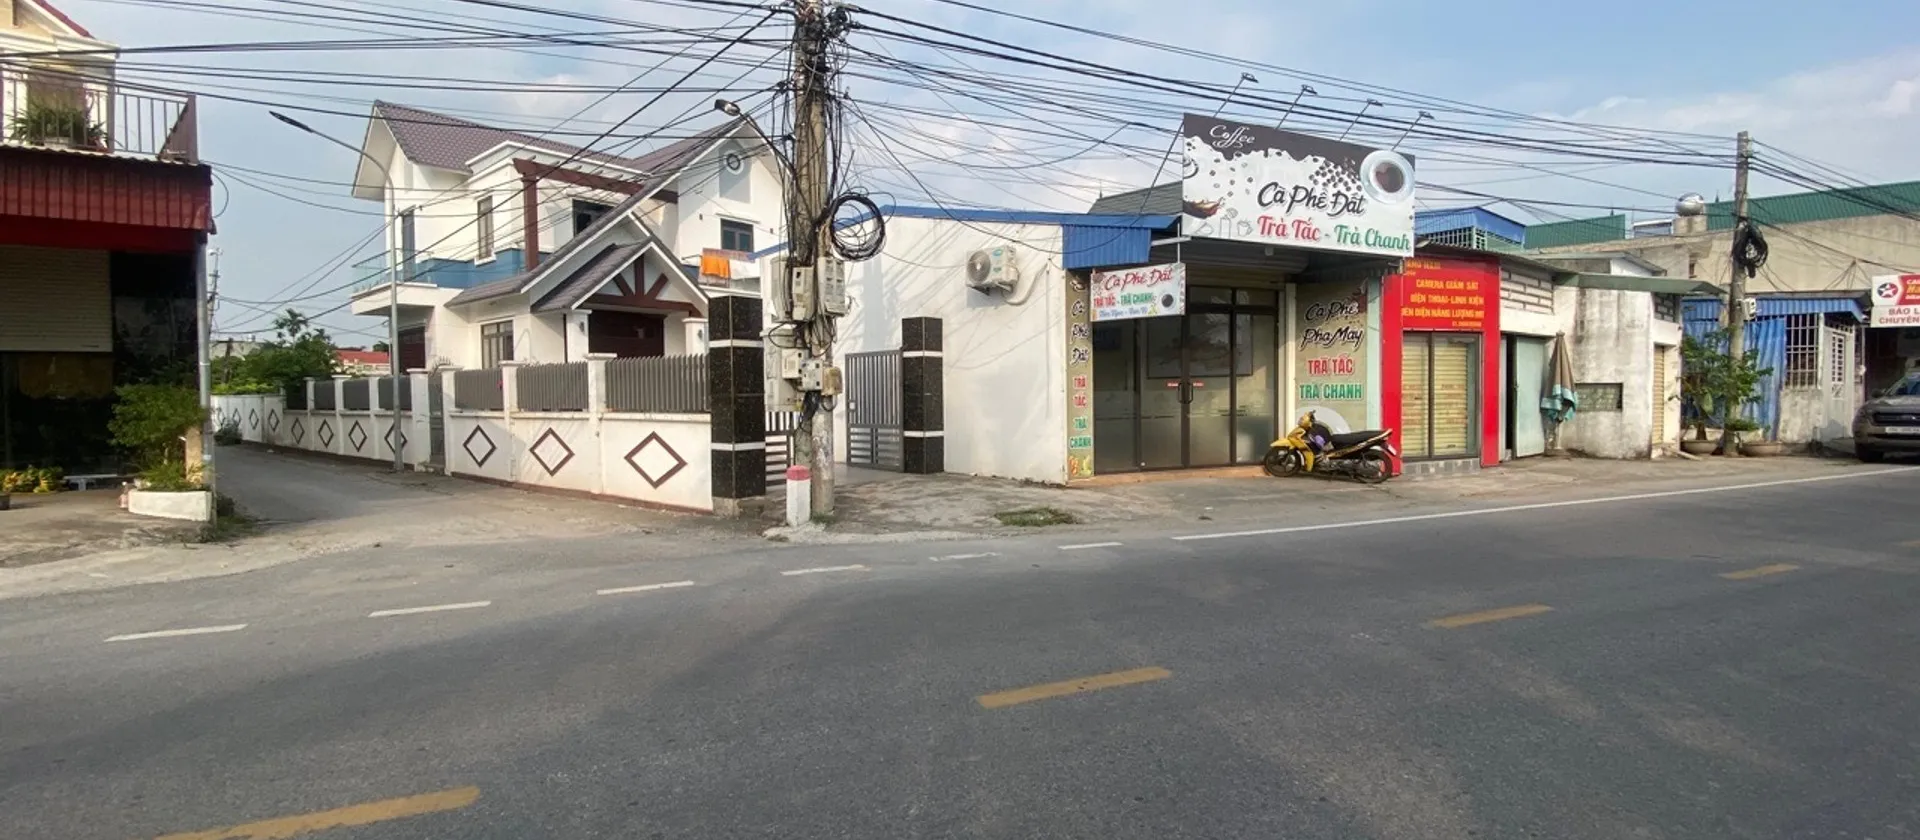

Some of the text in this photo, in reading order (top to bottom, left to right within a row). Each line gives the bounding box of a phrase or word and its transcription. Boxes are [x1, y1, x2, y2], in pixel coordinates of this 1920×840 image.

[1209, 124, 1256, 148] Coffee
[1286, 185, 1328, 214] Phê
[1326, 190, 1366, 217] Đất
[1257, 215, 1287, 237] Trà
[1291, 217, 1321, 241] Tắc
[1334, 224, 1361, 245] Trà
[1364, 227, 1411, 250] Chanh
[1300, 328, 1331, 350] Pha
[1323, 384, 1362, 399] CHANH
